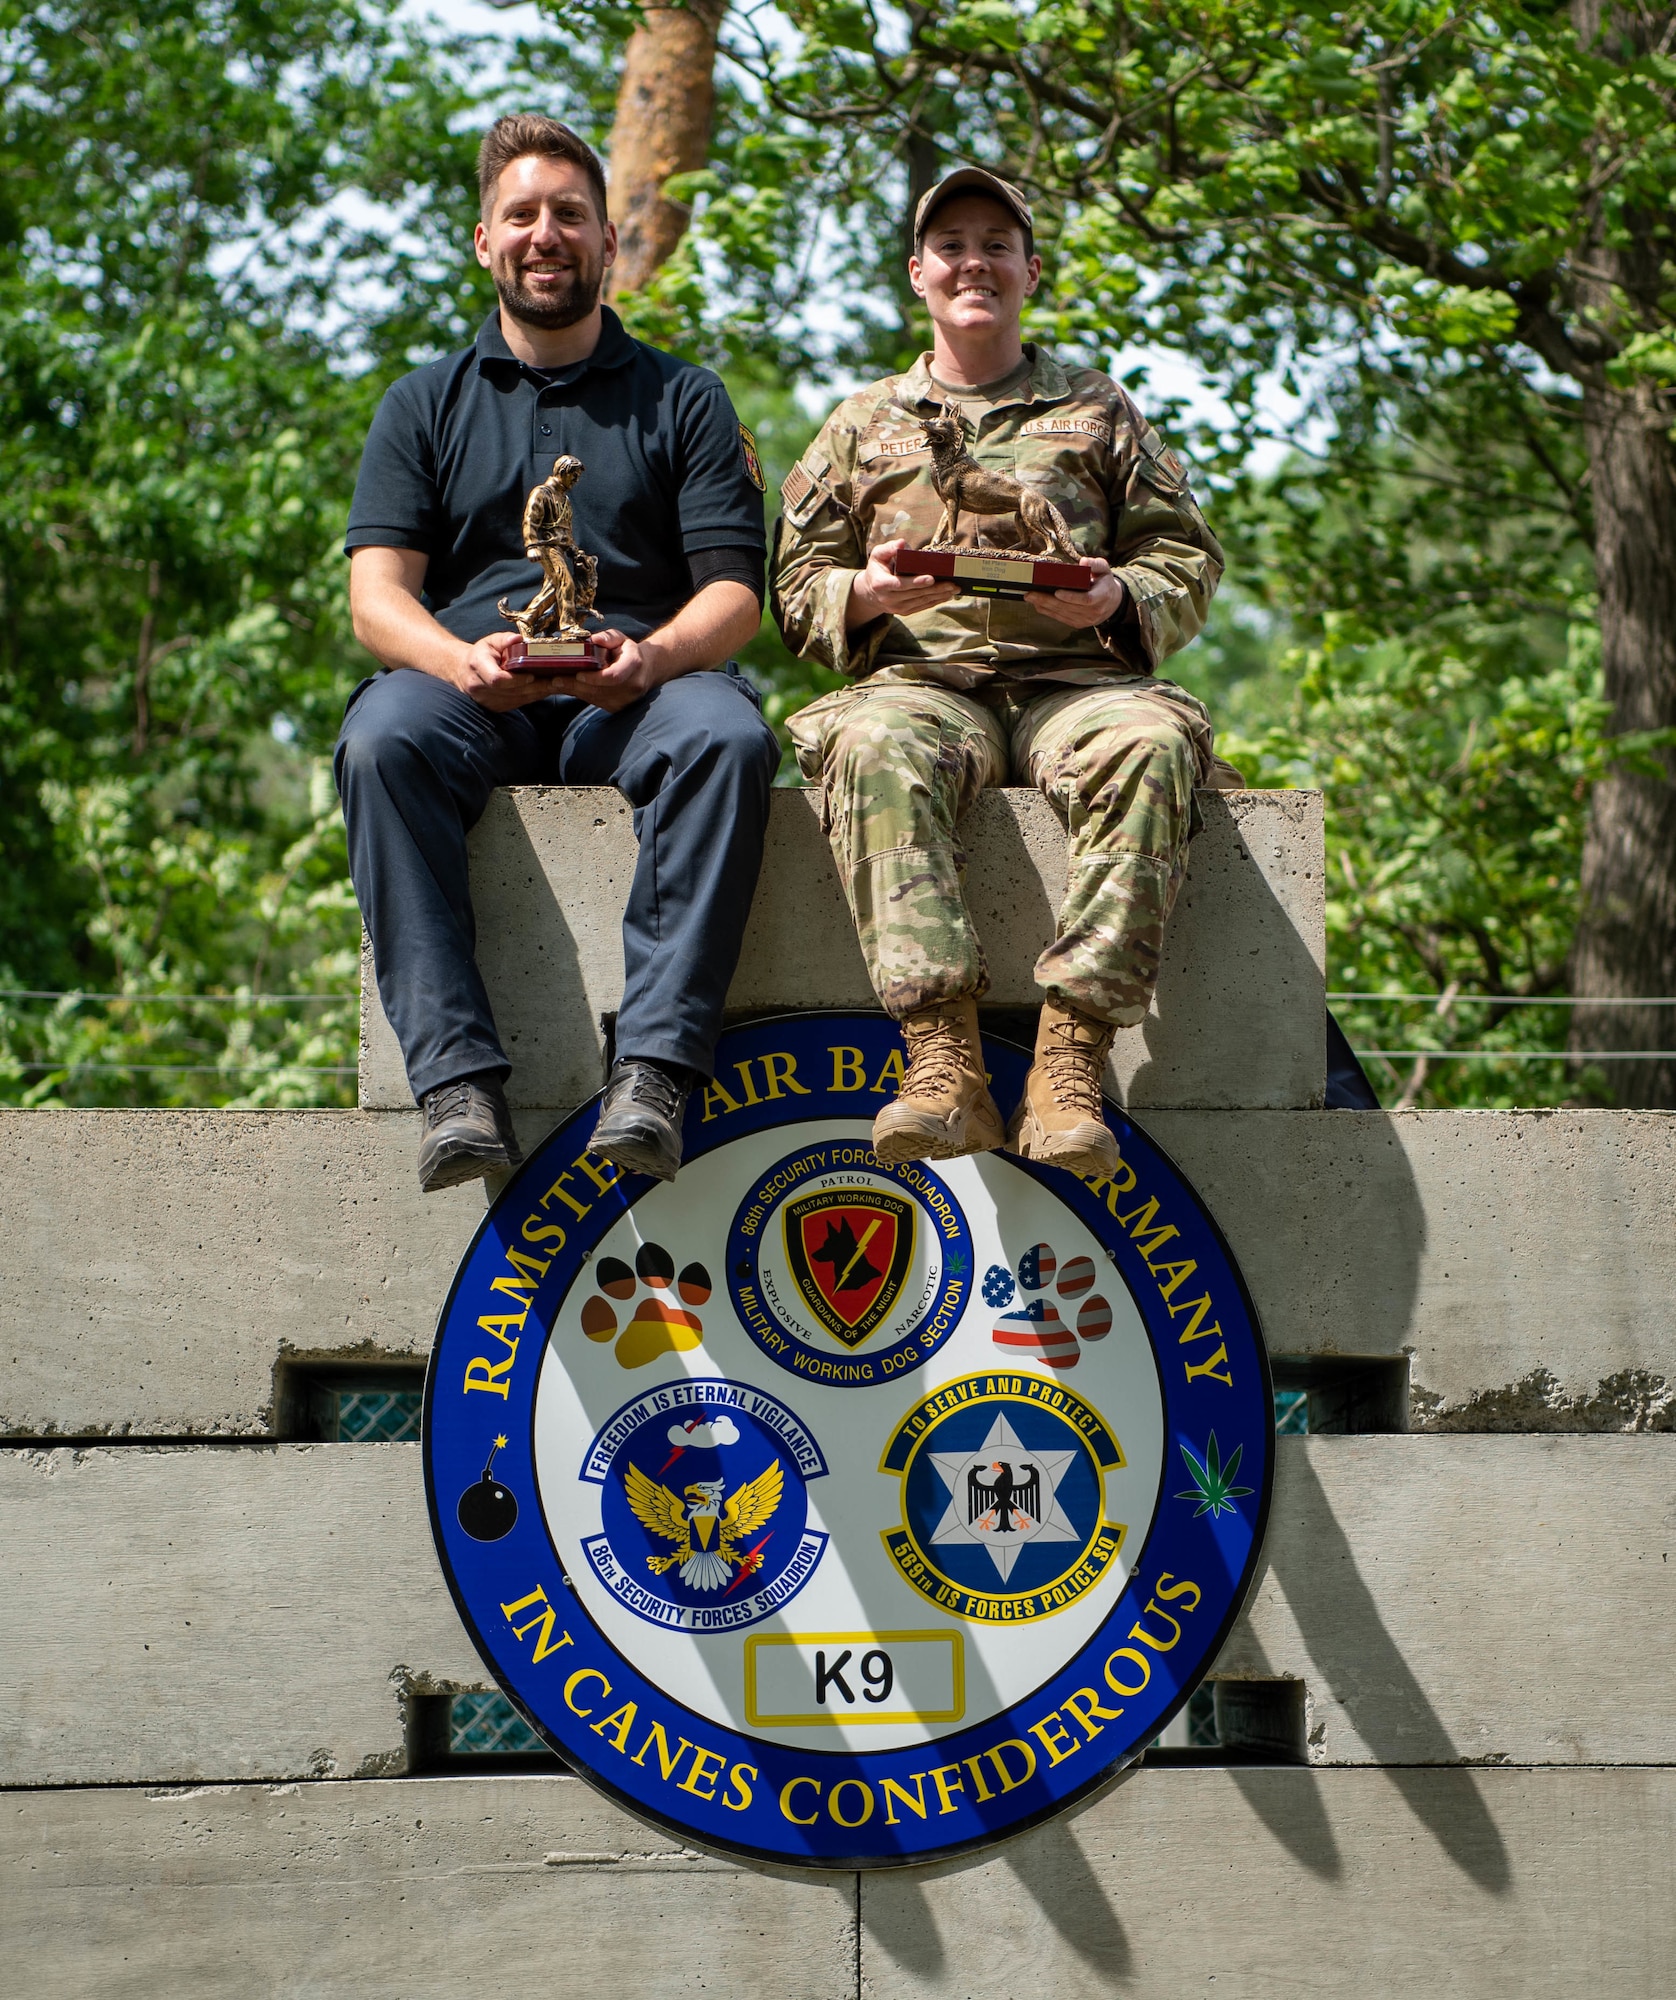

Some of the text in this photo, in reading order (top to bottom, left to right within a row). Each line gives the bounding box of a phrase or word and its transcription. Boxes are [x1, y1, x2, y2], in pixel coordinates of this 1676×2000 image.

[880, 437, 926, 454] PETER
[1025, 419, 1110, 441] U.S. AIR FORCE
[741, 1204, 766, 1236] 86th
[758, 1151, 826, 1204] SECURITY
[897, 1163, 961, 1239] SQUADRON
[792, 1194, 904, 1216] MILITARY WORKING DOG
[820, 1175, 873, 1188] PATROL
[463, 1149, 627, 1401] RAMSTE
[702, 1052, 812, 1123] AIR
[1071, 1156, 1233, 1387] RMANY
[738, 1279, 964, 1380] MILITARY WORKING DOG SECTION
[763, 1269, 812, 1340] EXPLOSIVE
[802, 1278, 897, 1338] GUARDIANS OF THE NIGHT
[894, 1265, 938, 1335] NARCOTIC
[590, 1385, 818, 1474] FREEDOM IS ETERNAL VIGILANCE
[903, 1377, 1102, 1439] TO SERVE AND PROTECT
[591, 1540, 818, 1627] 86TH SECURITY FORCES SQUADRON
[894, 1535, 1117, 1620] 569TH US FORCES POLICE SQ
[500, 1571, 1202, 1828] IN CANES CONFIDEROUS
[815, 1648, 894, 1704] K9
